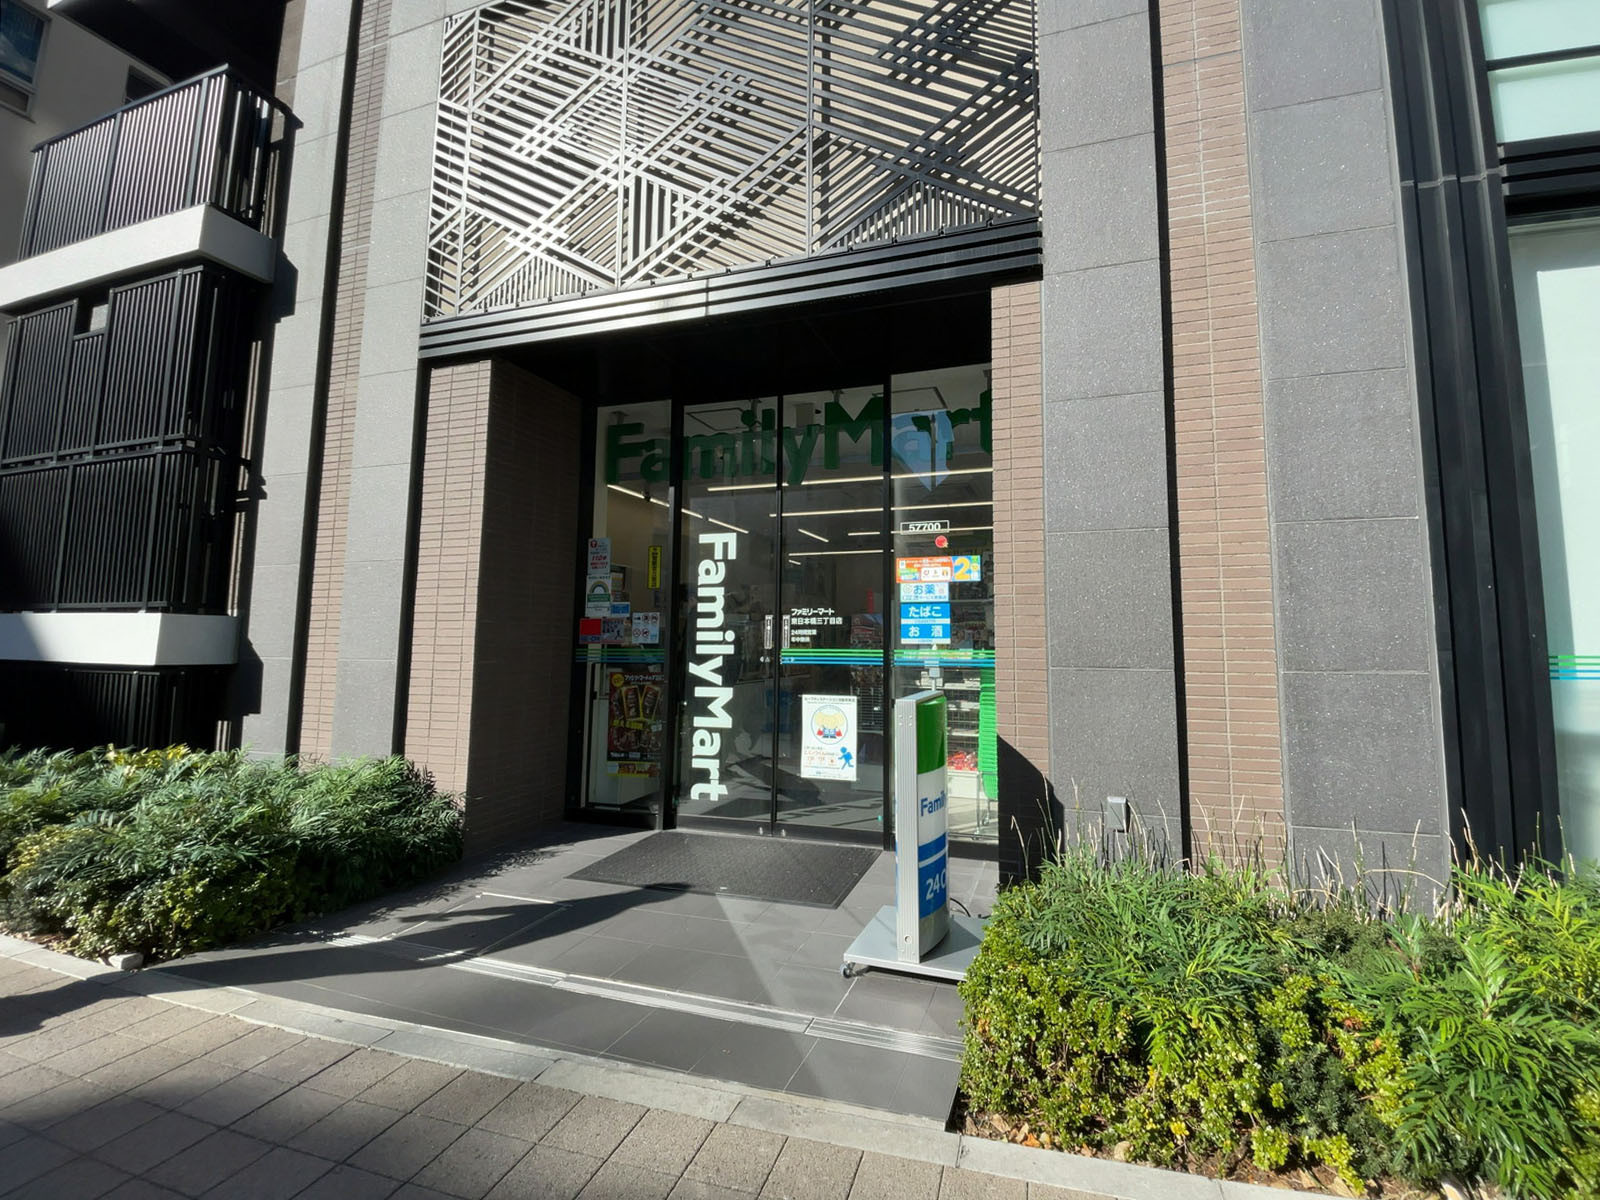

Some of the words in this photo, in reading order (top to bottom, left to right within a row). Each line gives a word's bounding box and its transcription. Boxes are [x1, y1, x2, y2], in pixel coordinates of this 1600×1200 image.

[908, 522, 941, 532] 57700
[913, 583, 936, 595] お薬
[791, 608, 835, 616] ファミリーマート
[908, 605, 942, 618] たばこ
[689, 532, 737, 801] FamilyMart
